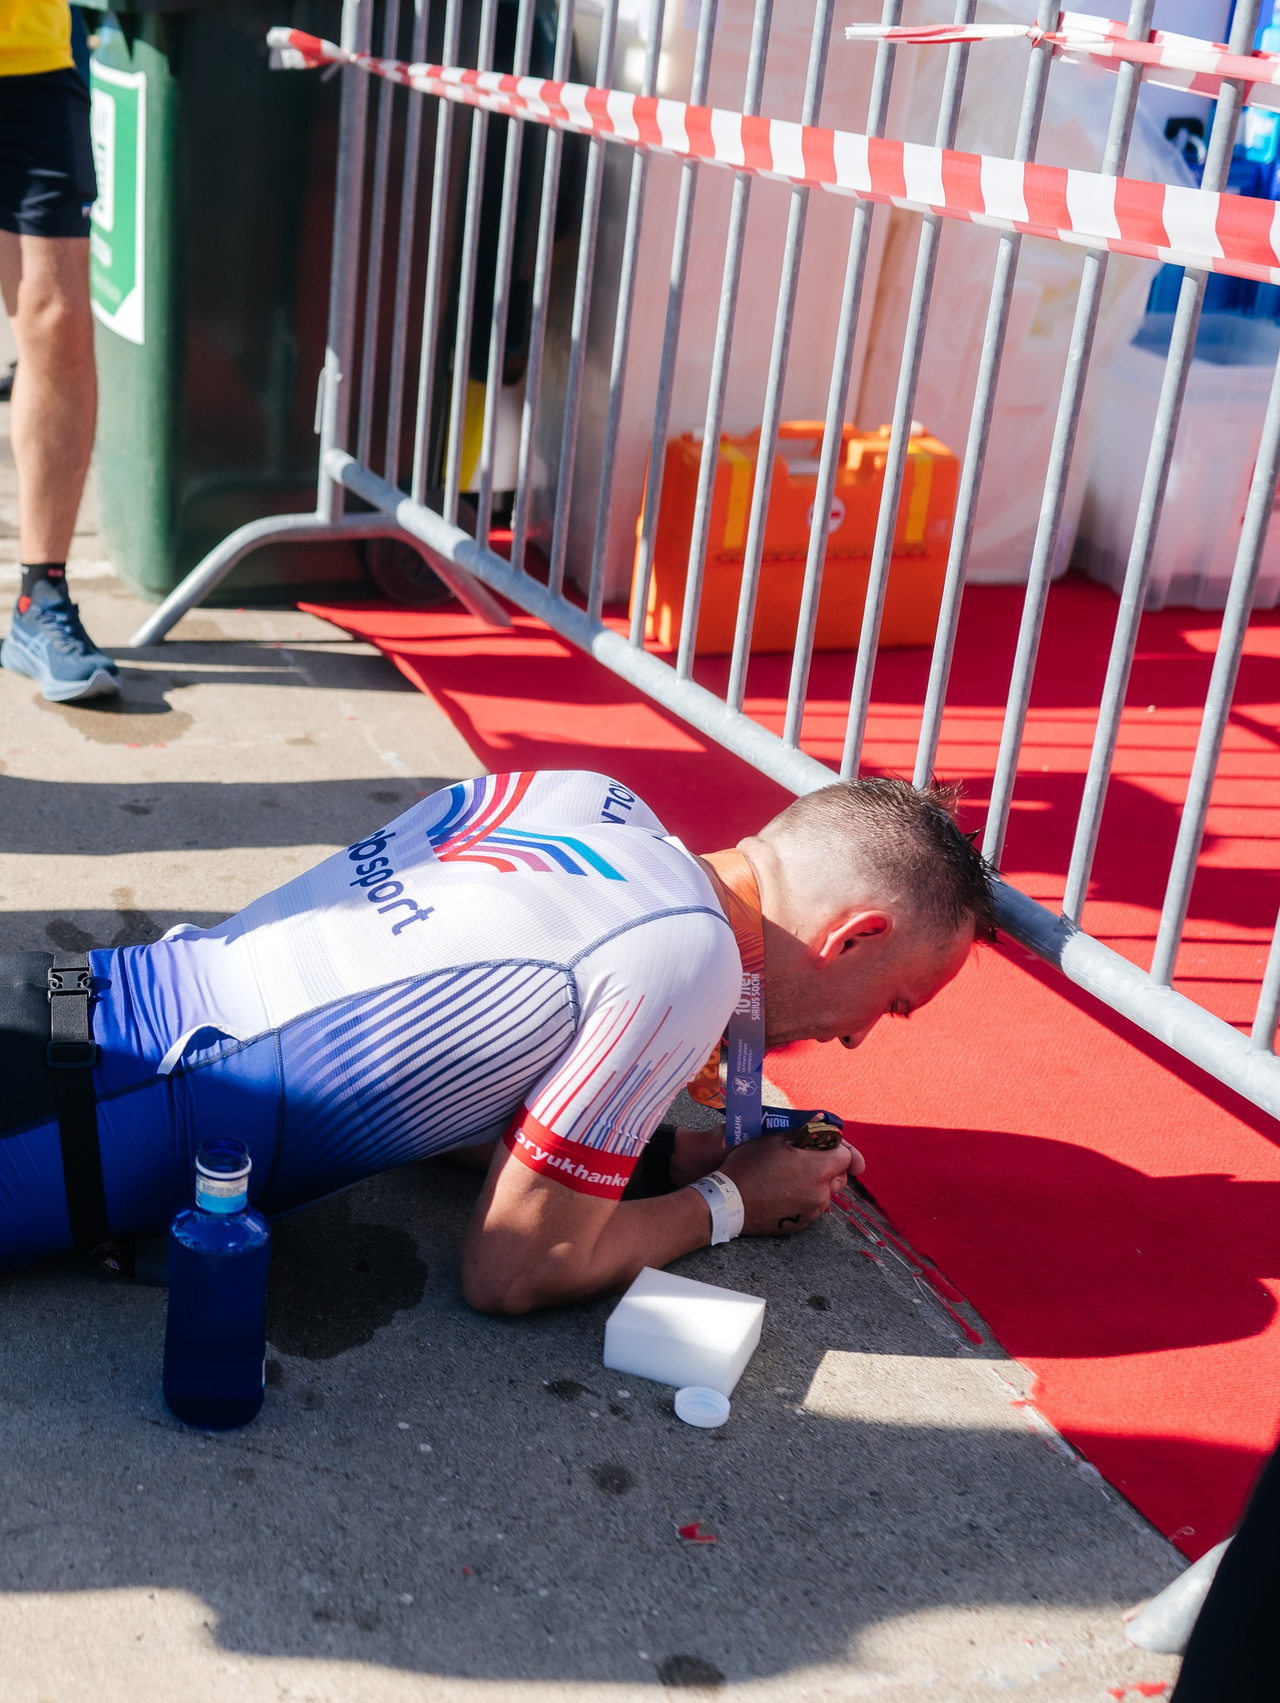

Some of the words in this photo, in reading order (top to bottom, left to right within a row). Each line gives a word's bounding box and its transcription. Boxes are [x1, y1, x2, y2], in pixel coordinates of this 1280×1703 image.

[751, 973, 760, 996] SOCHI
[751, 997, 760, 1021] SIRIUS
[766, 1117, 790, 1129] IRON
